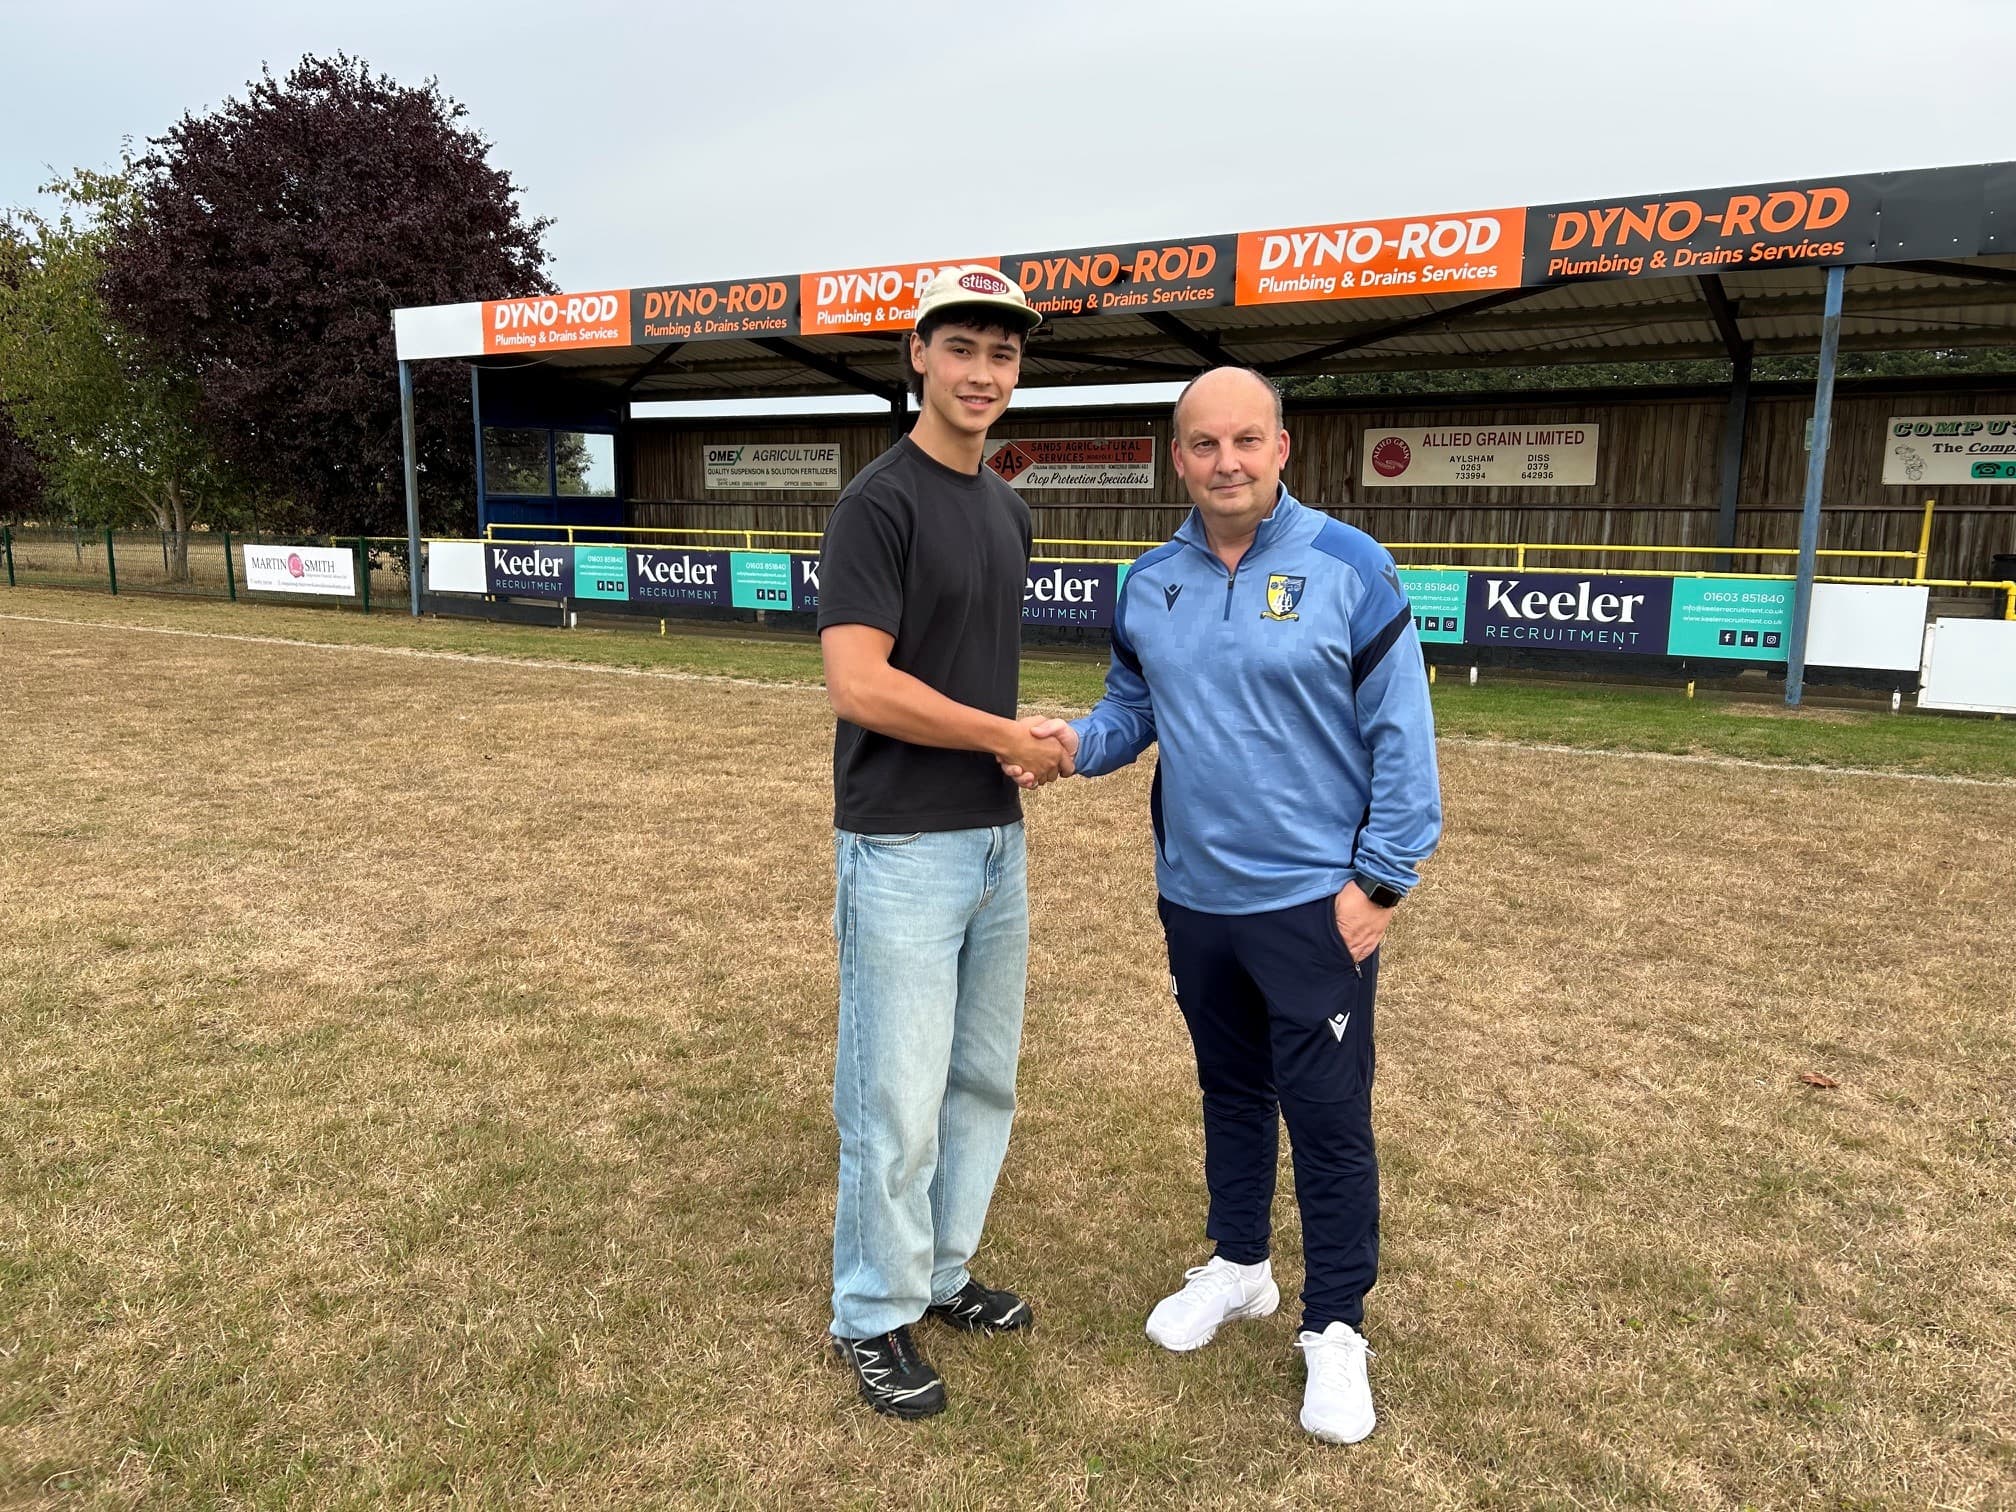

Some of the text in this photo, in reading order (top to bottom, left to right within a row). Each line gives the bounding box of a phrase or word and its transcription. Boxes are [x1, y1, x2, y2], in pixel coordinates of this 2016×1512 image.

[1550, 188, 1850, 250] DYNO-ROD
[1259, 218, 1501, 270] DYNO-ROD
[1548, 239, 1845, 276] Plumbing & Drains Services
[1019, 244, 1217, 291] DYNO-ROD
[816, 266, 960, 306] DYNO-R
[1258, 263, 1498, 293] Plumbing & Drains Services
[644, 282, 787, 319] DYNO-ROD
[1027, 285, 1215, 315] lumbing & Drains Services
[494, 295, 618, 330] DYNO-ROD
[816, 306, 919, 326] Plumbing & Drai
[644, 316, 787, 338] Plumbing & Drains Services
[495, 327, 618, 347] Plumbing & Drains Services
[1893, 420, 2016, 437] COMPU
[1031, 442, 1061, 451] SANDS
[1423, 430, 1585, 447] ALLIED GRAIN LIMITED
[709, 446, 835, 462] OMEX AGRICULTURE
[1038, 452, 1084, 462] SERVICES
[1115, 452, 1137, 462] LTD.
[1932, 442, 2016, 455] The Comp
[995, 450, 1023, 474] SAS
[1450, 454, 1495, 463] AYLSHAM
[1527, 454, 1550, 462] DISS
[801, 467, 837, 475] FERTILIZERS
[1527, 463, 1549, 471] 0379
[1026, 472, 1149, 486] Crop Protection Specialists
[1521, 472, 1554, 480] 642936
[251, 557, 335, 573] MARTIN SMITH
[493, 549, 563, 577] Keeler
[636, 554, 718, 585] Keeler
[495, 579, 564, 592] RECRUITMENT
[639, 587, 719, 600] RECRUITMENT
[1424, 583, 1460, 592] 851840
[1487, 579, 1645, 623] Keeler
[1703, 592, 1785, 604] 01603 851840
[1022, 606, 1098, 620] RUITMENT
[1486, 625, 1640, 645] RECRUITMENT
